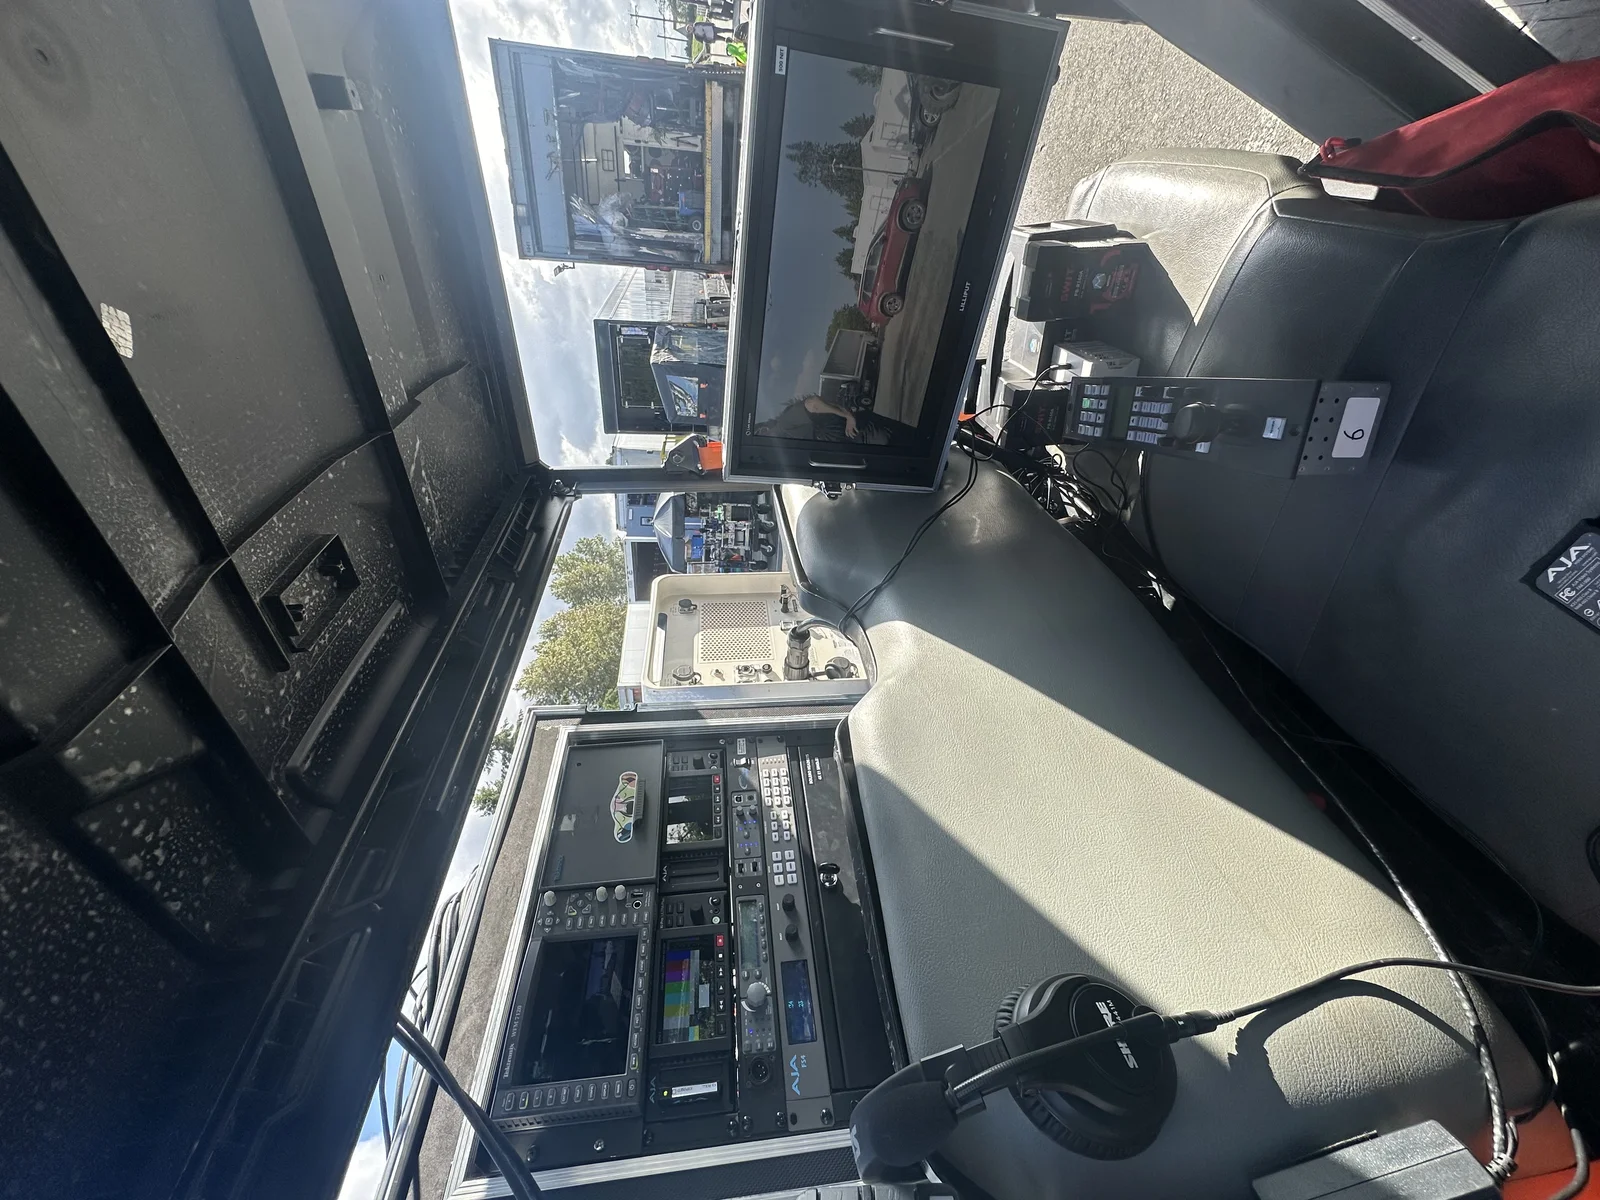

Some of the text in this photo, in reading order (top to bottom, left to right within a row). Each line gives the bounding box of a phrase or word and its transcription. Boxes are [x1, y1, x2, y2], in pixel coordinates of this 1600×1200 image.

[958, 281, 971, 312] LILLIPUT
[1343, 428, 1365, 441] 6
[1547, 545, 1590, 583] AJA
[1095, 1001, 1139, 1069] SHRE
[501, 1043, 515, 1079] Tektronix
[789, 1054, 801, 1096] AJA
